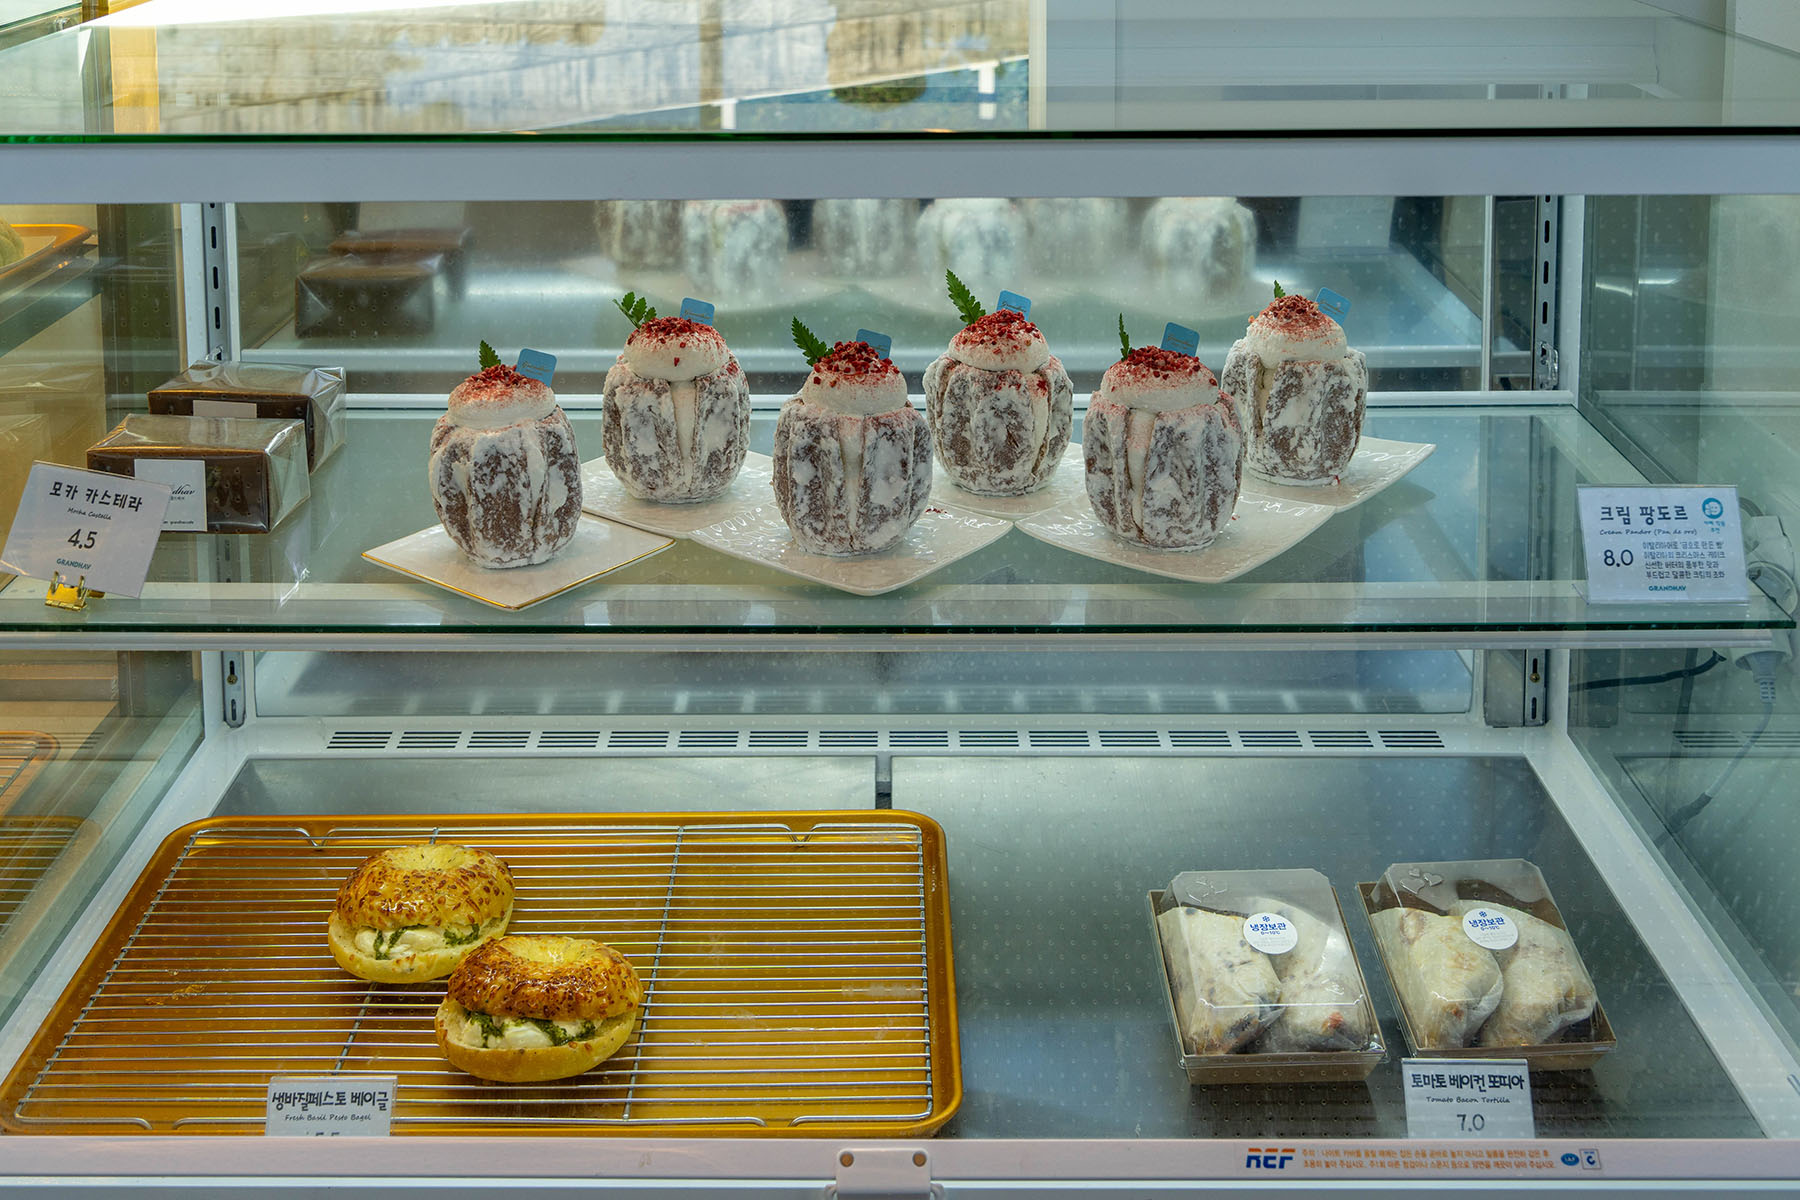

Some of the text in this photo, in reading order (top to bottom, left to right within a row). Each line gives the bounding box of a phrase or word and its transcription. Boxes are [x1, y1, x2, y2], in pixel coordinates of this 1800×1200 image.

[50, 481, 143, 512] 모카 카스테라
[68, 507, 112, 520] Mocha Castella
[1600, 506, 1688, 525] 크림 팡도르
[68, 529, 98, 549] 4.5
[1603, 549, 1633, 567] 8.0
[1645, 561, 1663, 569] 신선한
[1646, 571, 1670, 579] 부드럽고
[1672, 571, 1691, 579] 달콤한
[1713, 571, 1725, 579] 조화
[1250, 923, 1286, 931] 냉장보관
[1469, 917, 1505, 927] 냉장보관
[1412, 1074, 1525, 1092] 토마토 베이컨 또띠아
[272, 1092, 388, 1111] 생바질페스토 베이글
[1457, 1114, 1485, 1132] 7.0
